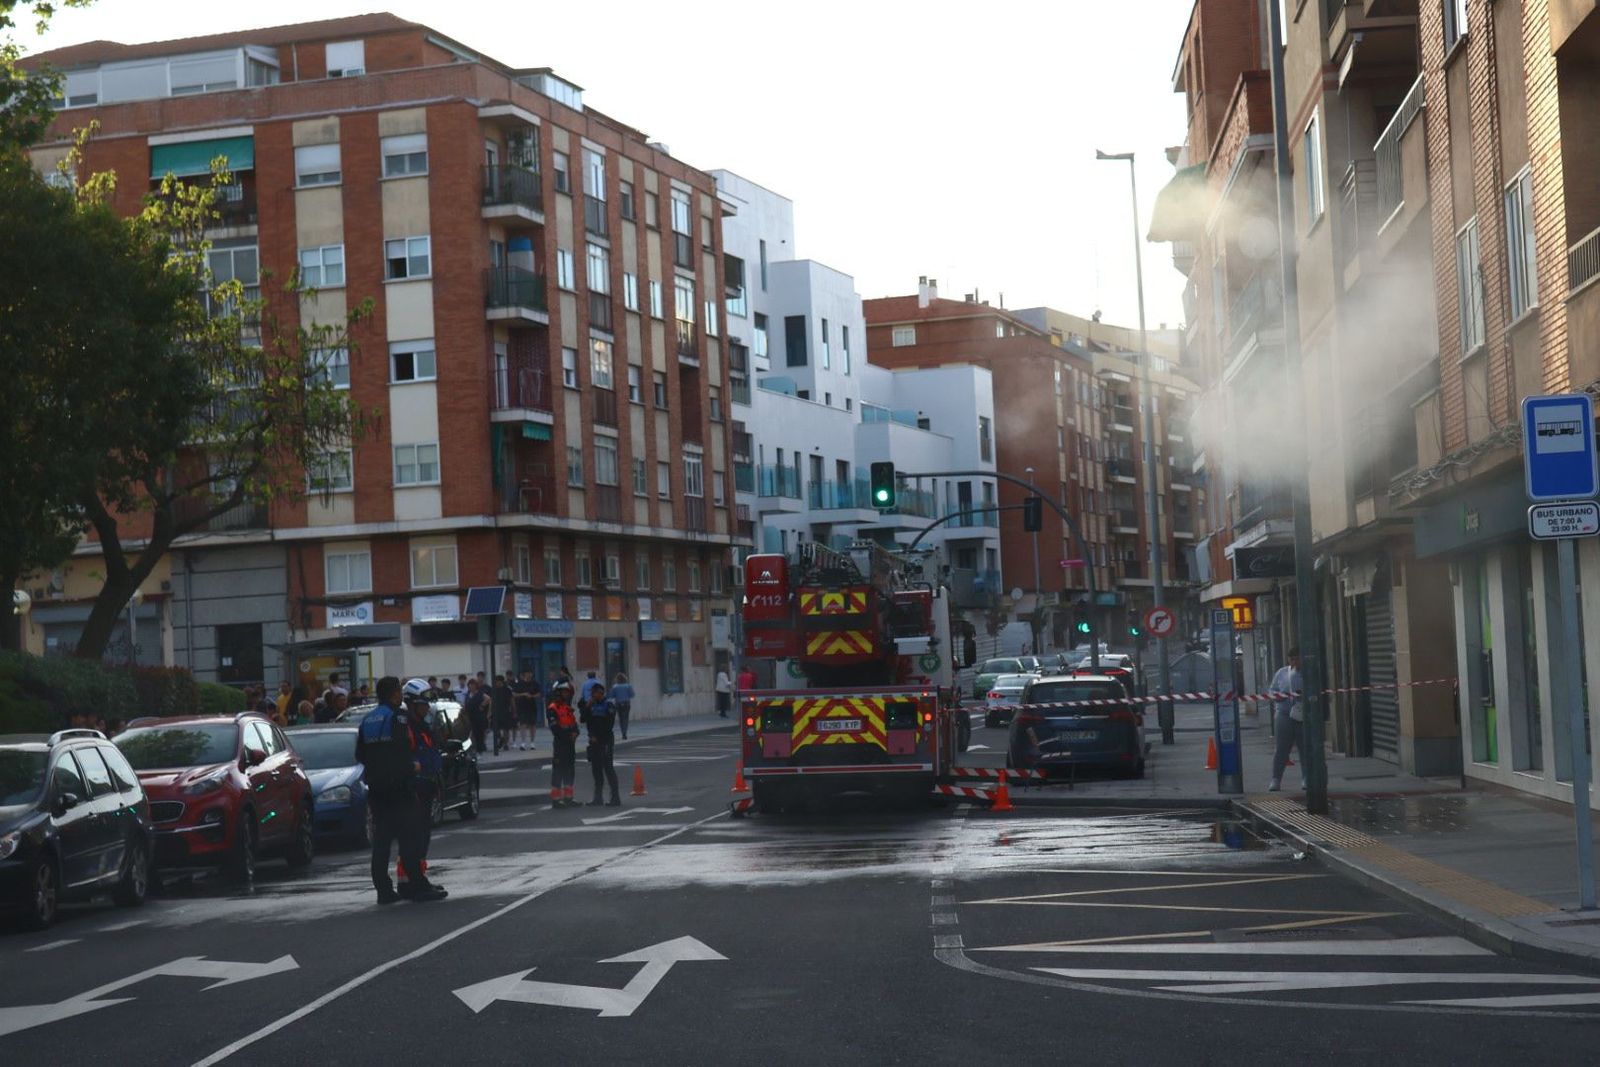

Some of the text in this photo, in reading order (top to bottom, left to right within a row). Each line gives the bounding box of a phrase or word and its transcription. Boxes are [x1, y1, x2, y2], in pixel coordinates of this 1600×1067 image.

[1537, 508, 1593, 518] BUS URBANO
[1548, 518, 1559, 526] DE
[761, 595, 783, 606] 112
